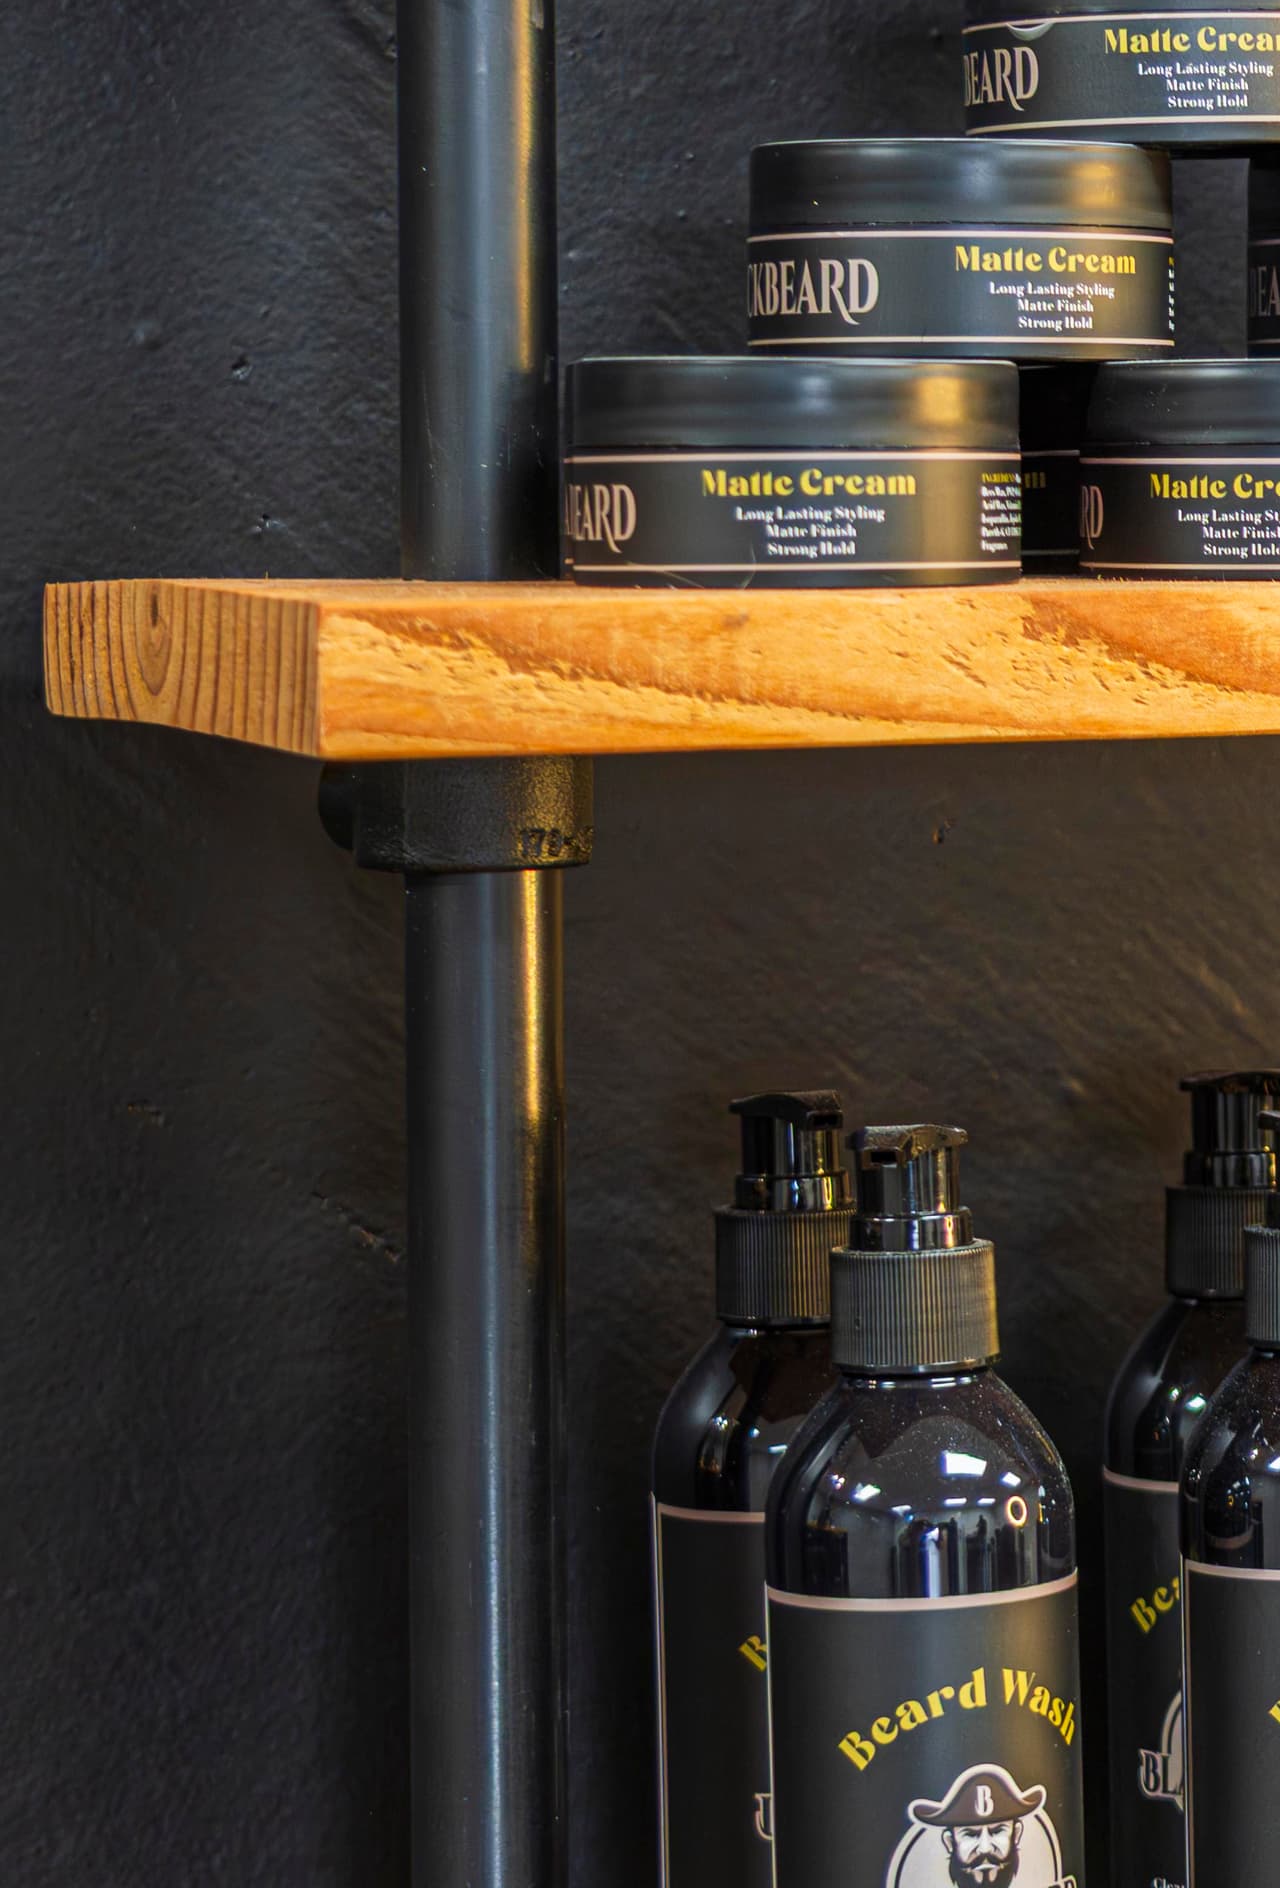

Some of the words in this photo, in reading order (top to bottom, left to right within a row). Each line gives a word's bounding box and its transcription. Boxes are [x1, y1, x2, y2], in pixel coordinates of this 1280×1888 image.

[1104, 27, 1190, 54] Matte
[1137, 61, 1173, 77] Long
[1175, 62, 1227, 76] Lasting
[1228, 61, 1274, 77] Styling
[1207, 78, 1249, 92] Finish
[1168, 95, 1214, 110] Strong
[955, 245, 1043, 274] Matte
[1048, 246, 1137, 275] Cream
[702, 468, 795, 497] Matte
[799, 467, 917, 497] Cream
[1149, 472, 1228, 500] Matte
[1177, 509, 1210, 525] Long
[1212, 509, 1262, 524] Lasting
[1202, 526, 1240, 540] Matte
[1203, 543, 1249, 558] Strong
[838, 1667, 988, 1772] Beard
[1002, 1667, 1077, 1747] Wash
